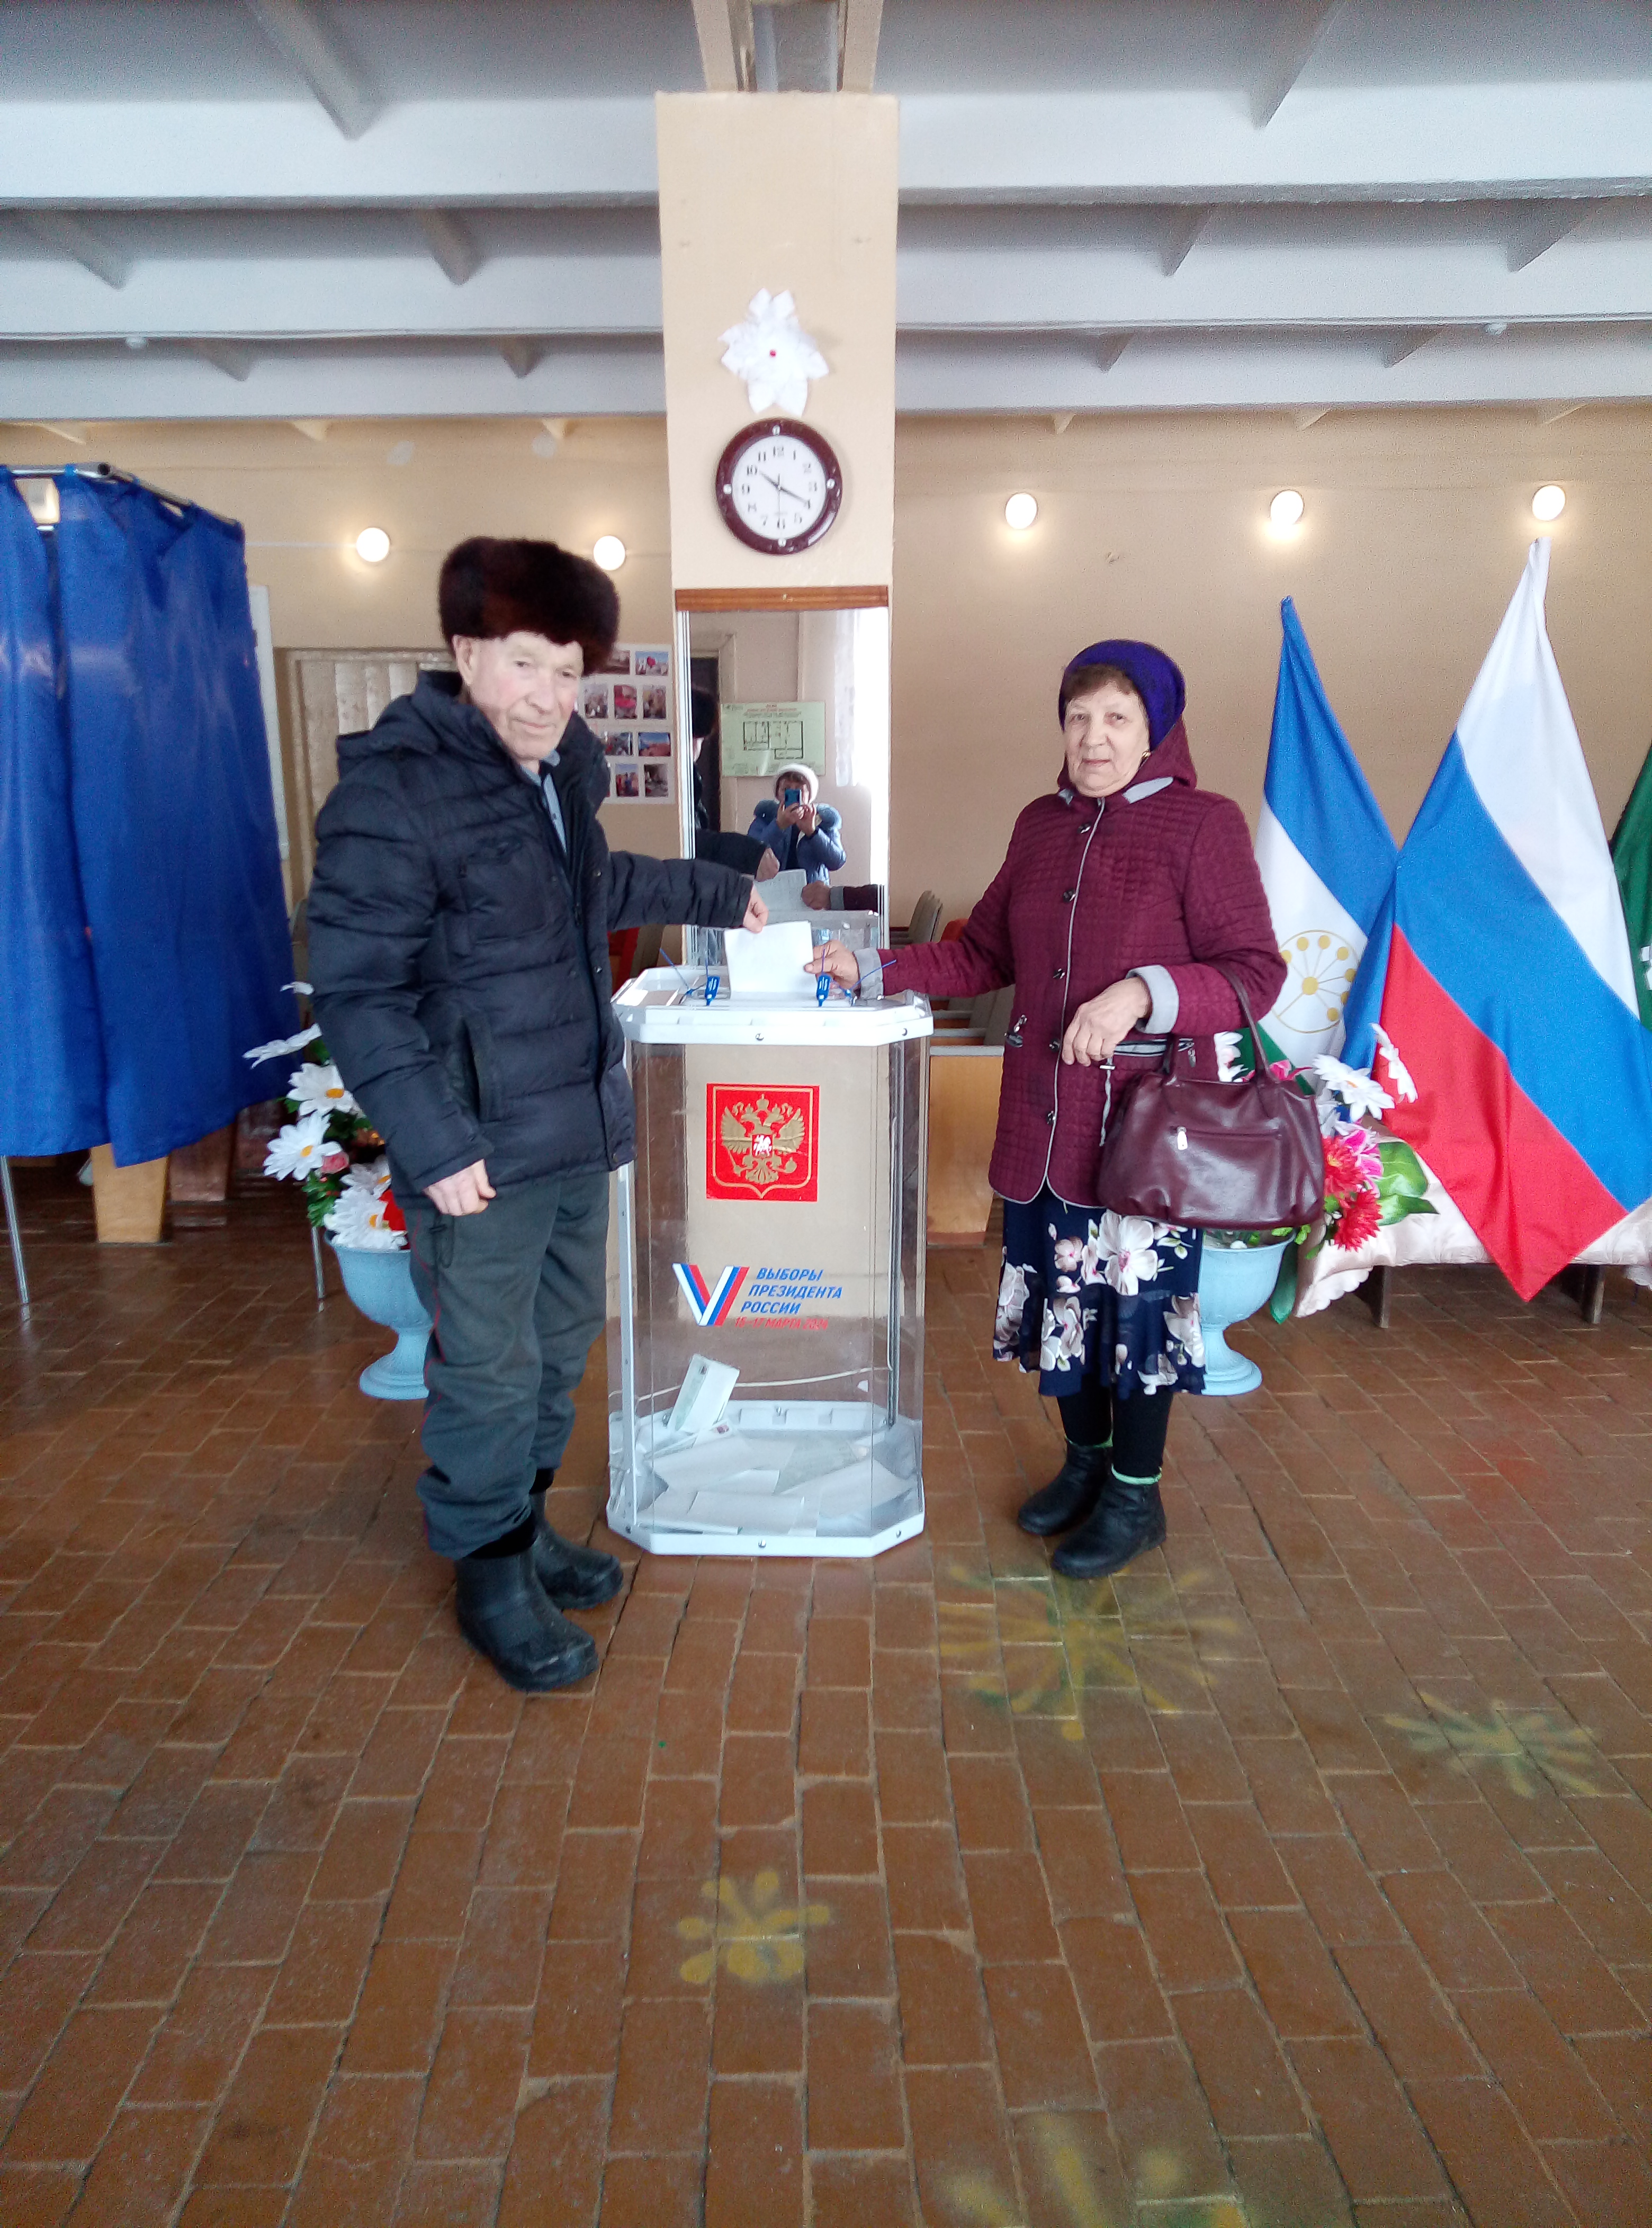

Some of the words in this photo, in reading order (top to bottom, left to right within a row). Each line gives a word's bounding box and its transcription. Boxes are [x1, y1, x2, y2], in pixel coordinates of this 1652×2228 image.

[758, 451, 767, 462] 11
[773, 445, 785, 457] 12
[746, 464, 758, 475] 10
[756, 1267, 823, 1281] ВЫБОРЫ
[747, 1284, 843, 1300] ПРЕЗИДЕНТА
[740, 1301, 802, 1315] РОССИИ
[765, 1317, 802, 1330] МАРТА
